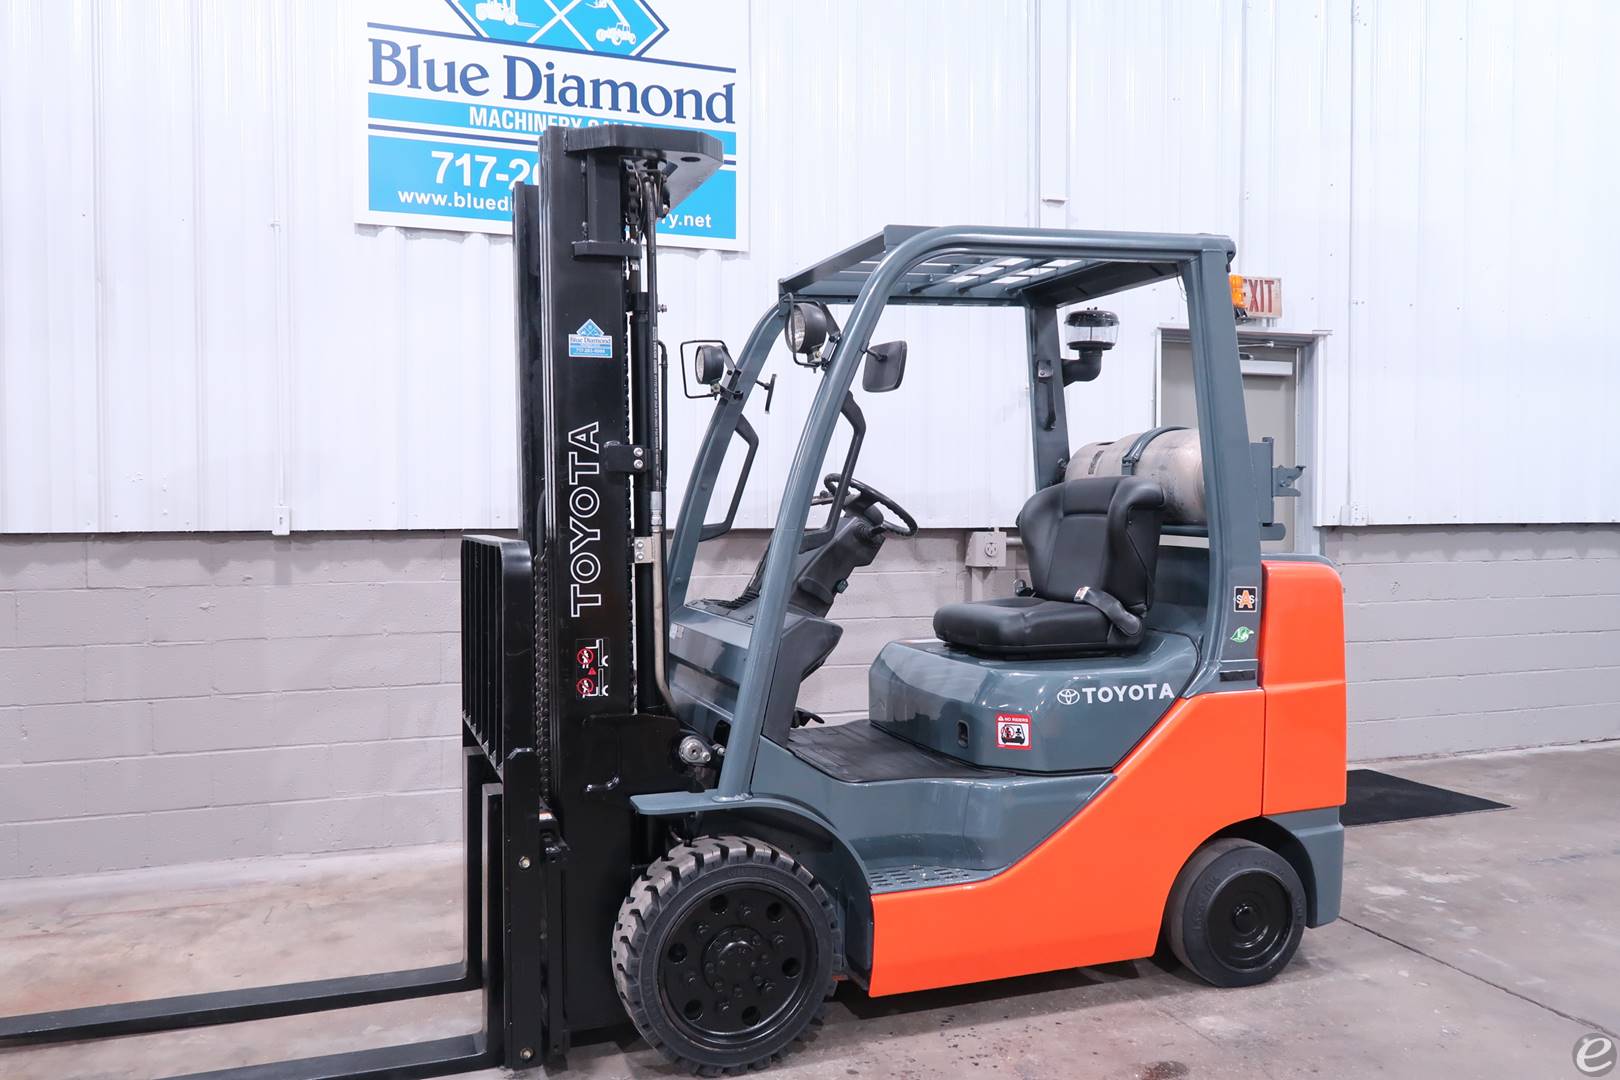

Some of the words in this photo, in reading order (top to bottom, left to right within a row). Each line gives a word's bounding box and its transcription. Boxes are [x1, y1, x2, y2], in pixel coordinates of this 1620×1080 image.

[368, 38, 490, 97] Blue
[503, 55, 736, 124] Diamond
[431, 150, 539, 190] 717-2
[1243, 279, 1275, 313] XIT
[568, 421, 601, 617] TOYOTA
[1082, 682, 1175, 704] TOYOTA
